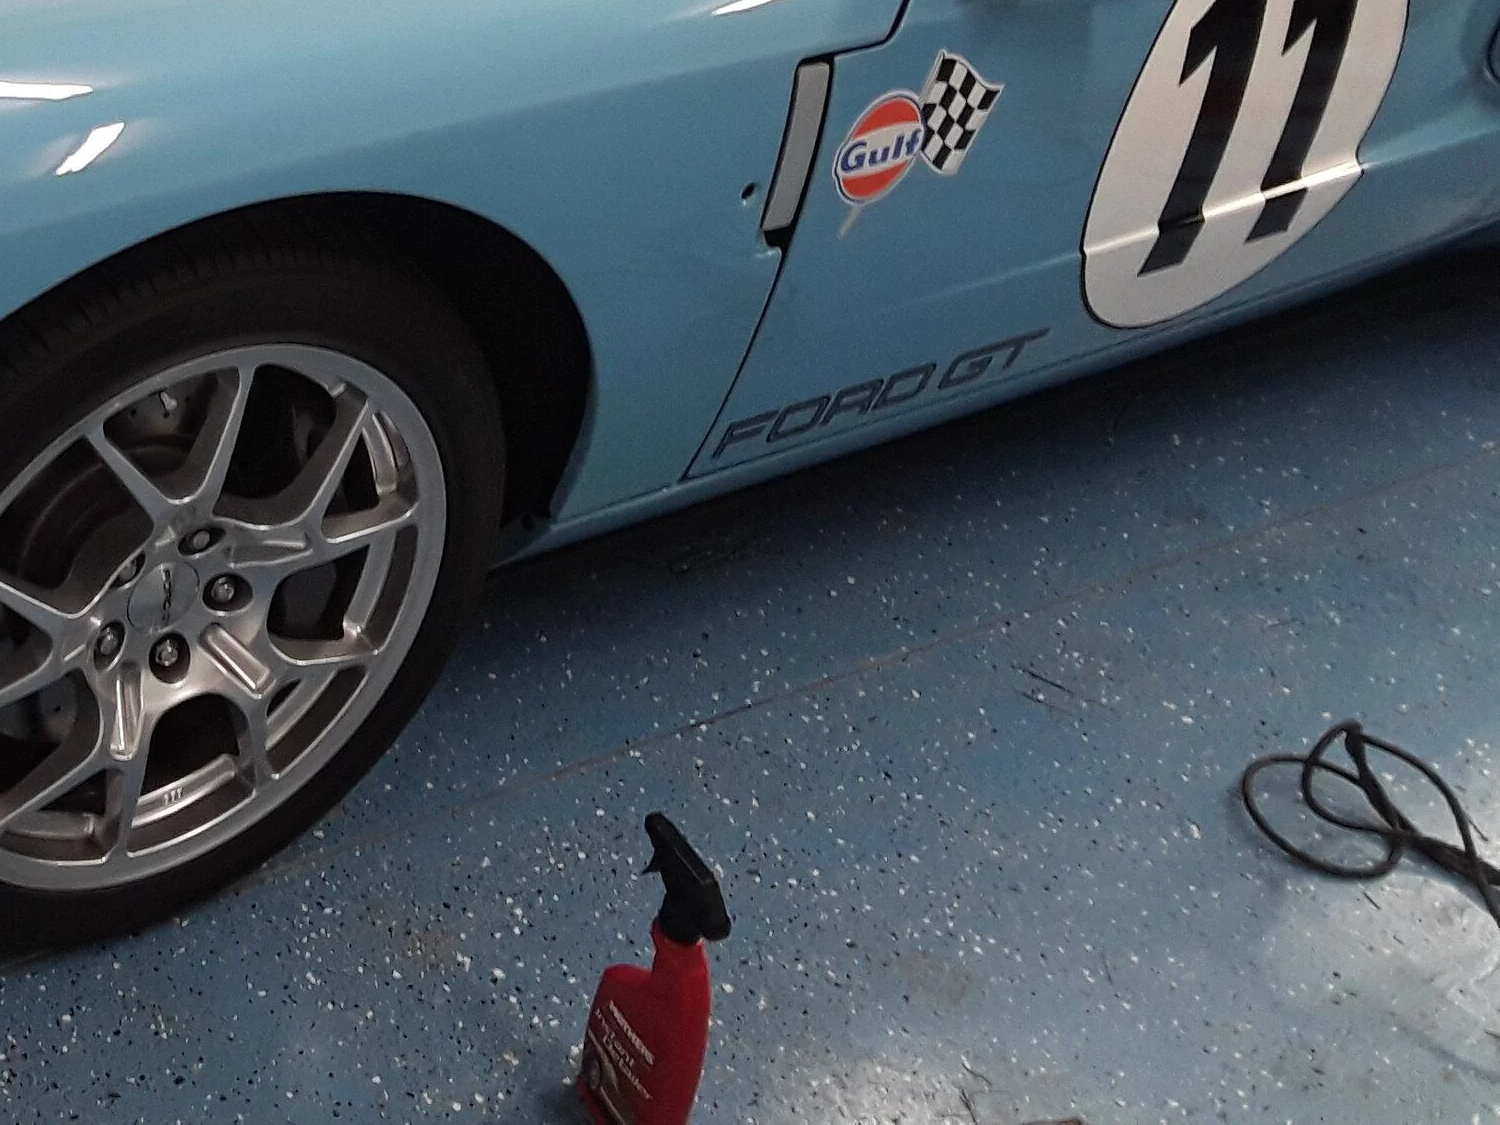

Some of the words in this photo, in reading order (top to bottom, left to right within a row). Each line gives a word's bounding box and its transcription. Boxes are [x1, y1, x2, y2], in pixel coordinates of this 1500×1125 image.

[839, 128, 923, 174] Gulf
[711, 361, 938, 460] FORD
[938, 327, 1052, 392] GT
